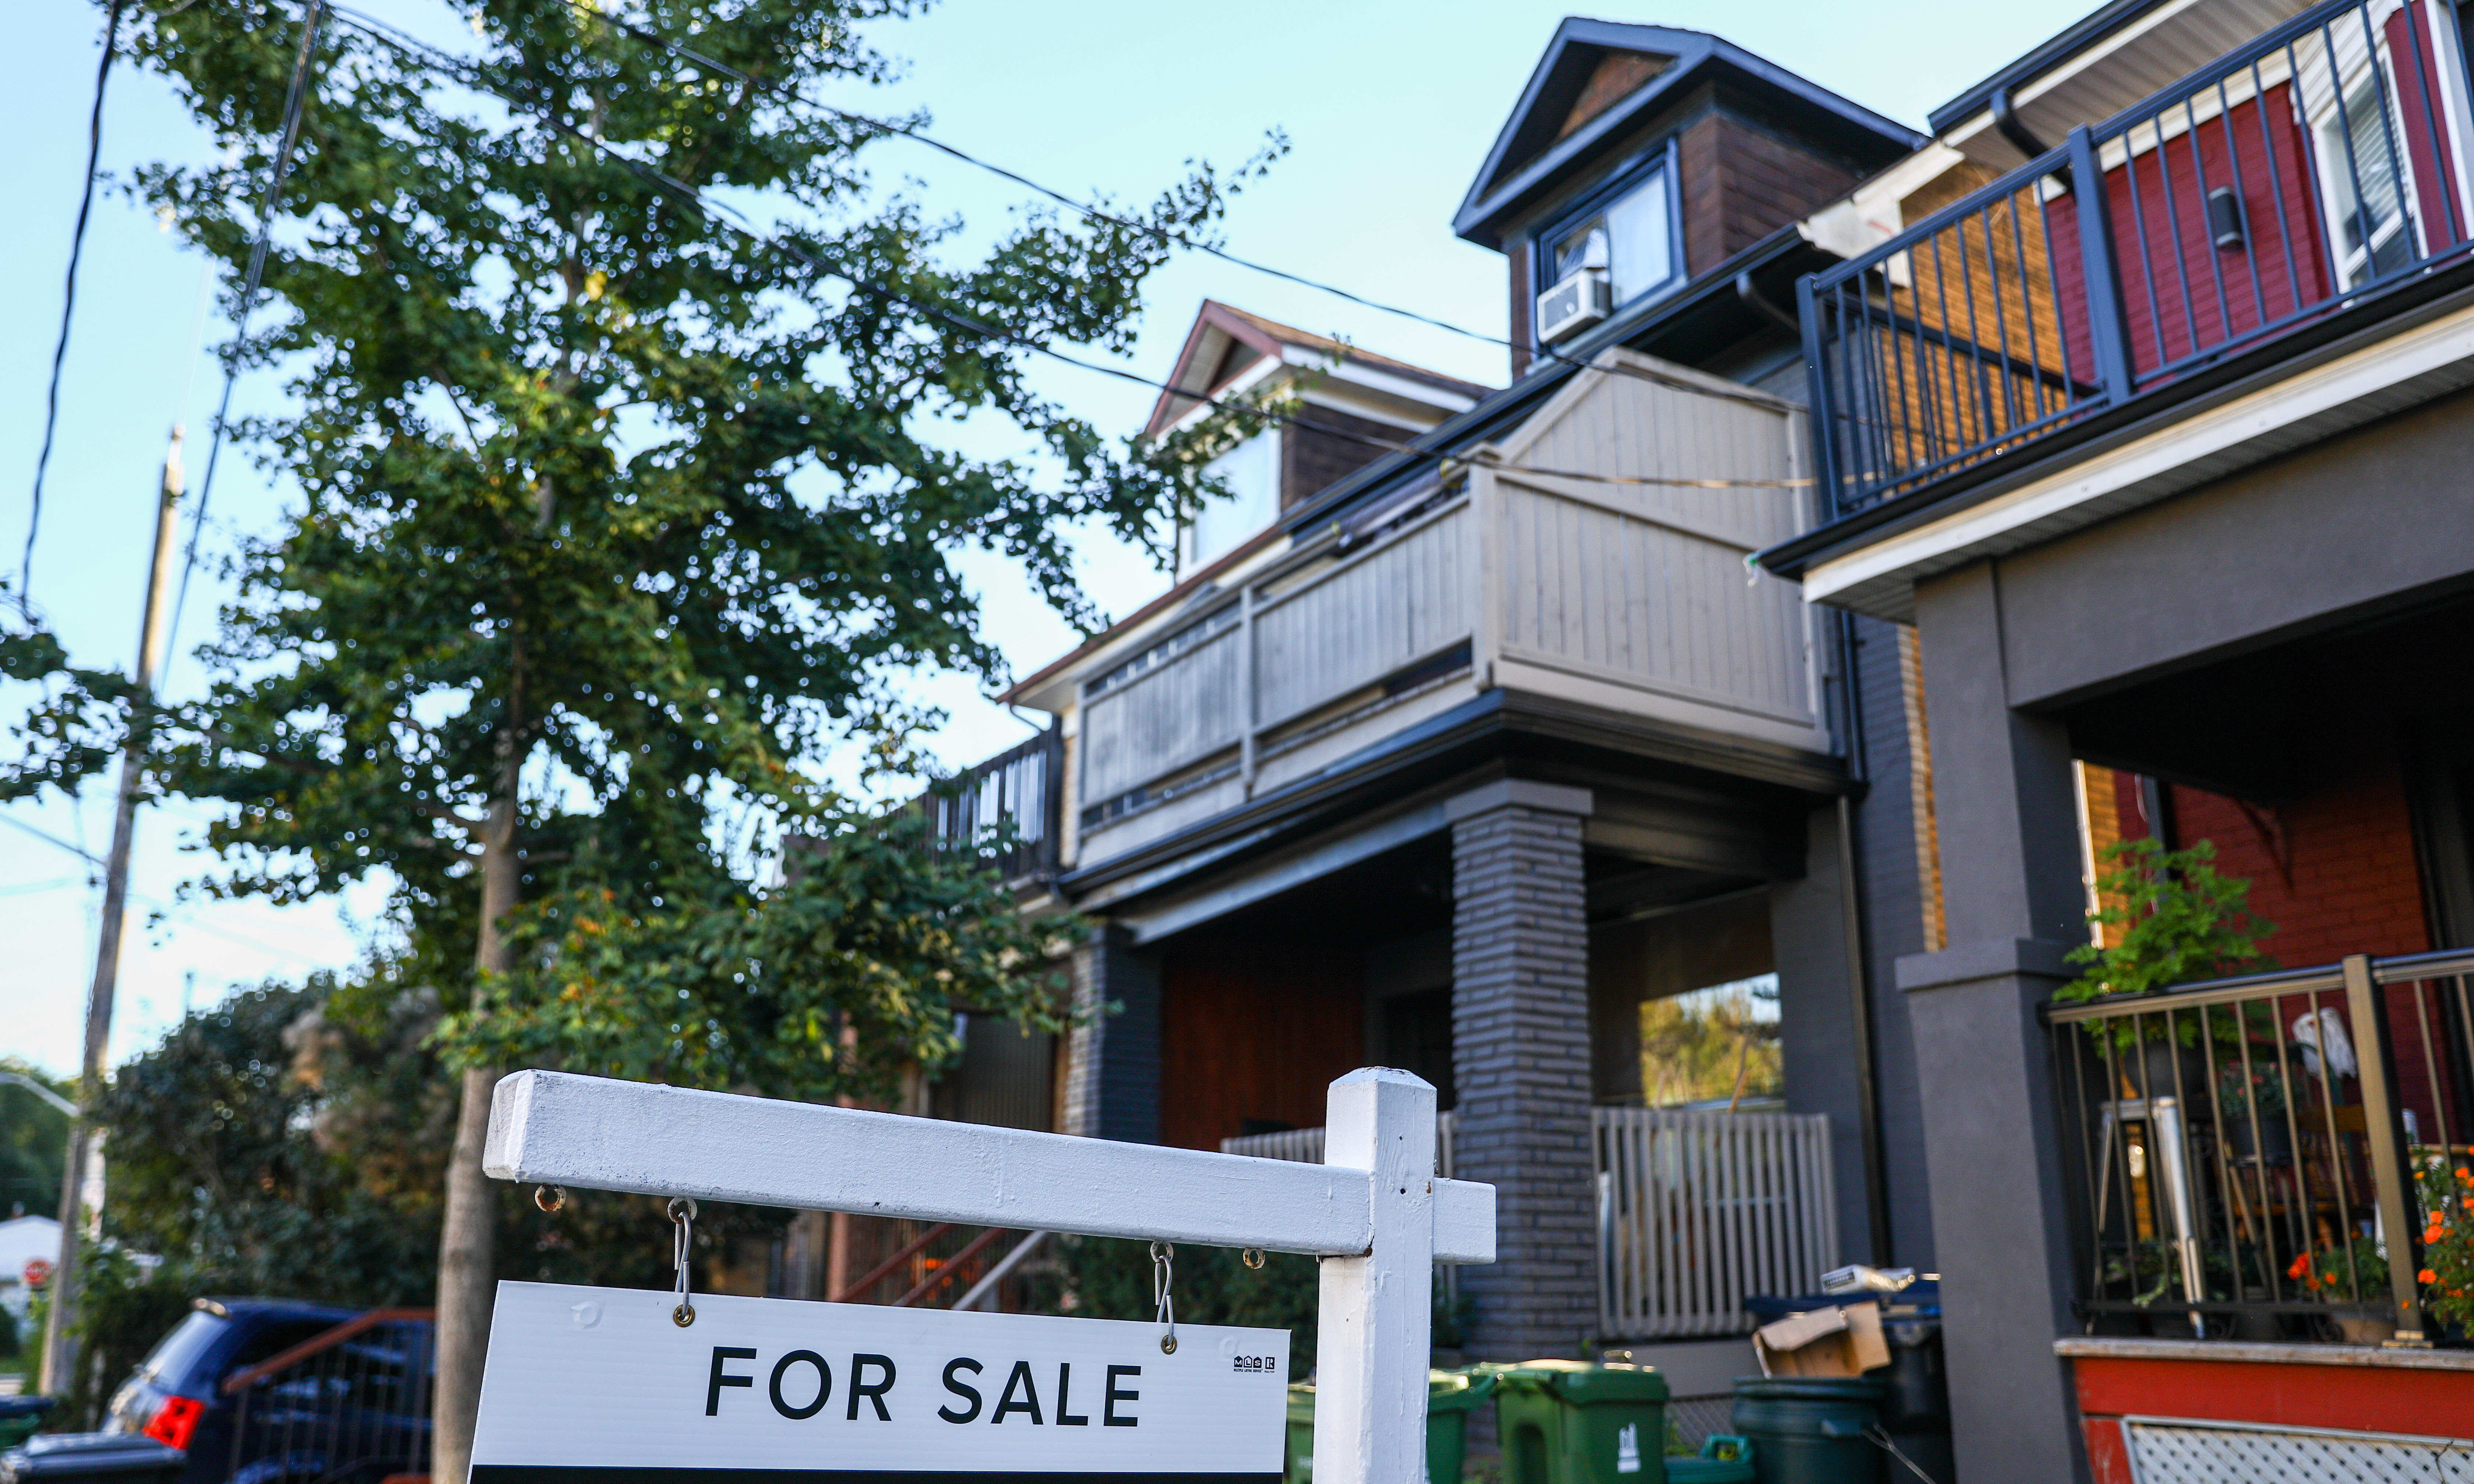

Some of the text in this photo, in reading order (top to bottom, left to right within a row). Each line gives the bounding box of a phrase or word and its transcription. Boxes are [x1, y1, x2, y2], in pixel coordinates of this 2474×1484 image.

[1234, 1357, 1262, 1367] MLS
[705, 1346, 1141, 1427] FOR SALE
